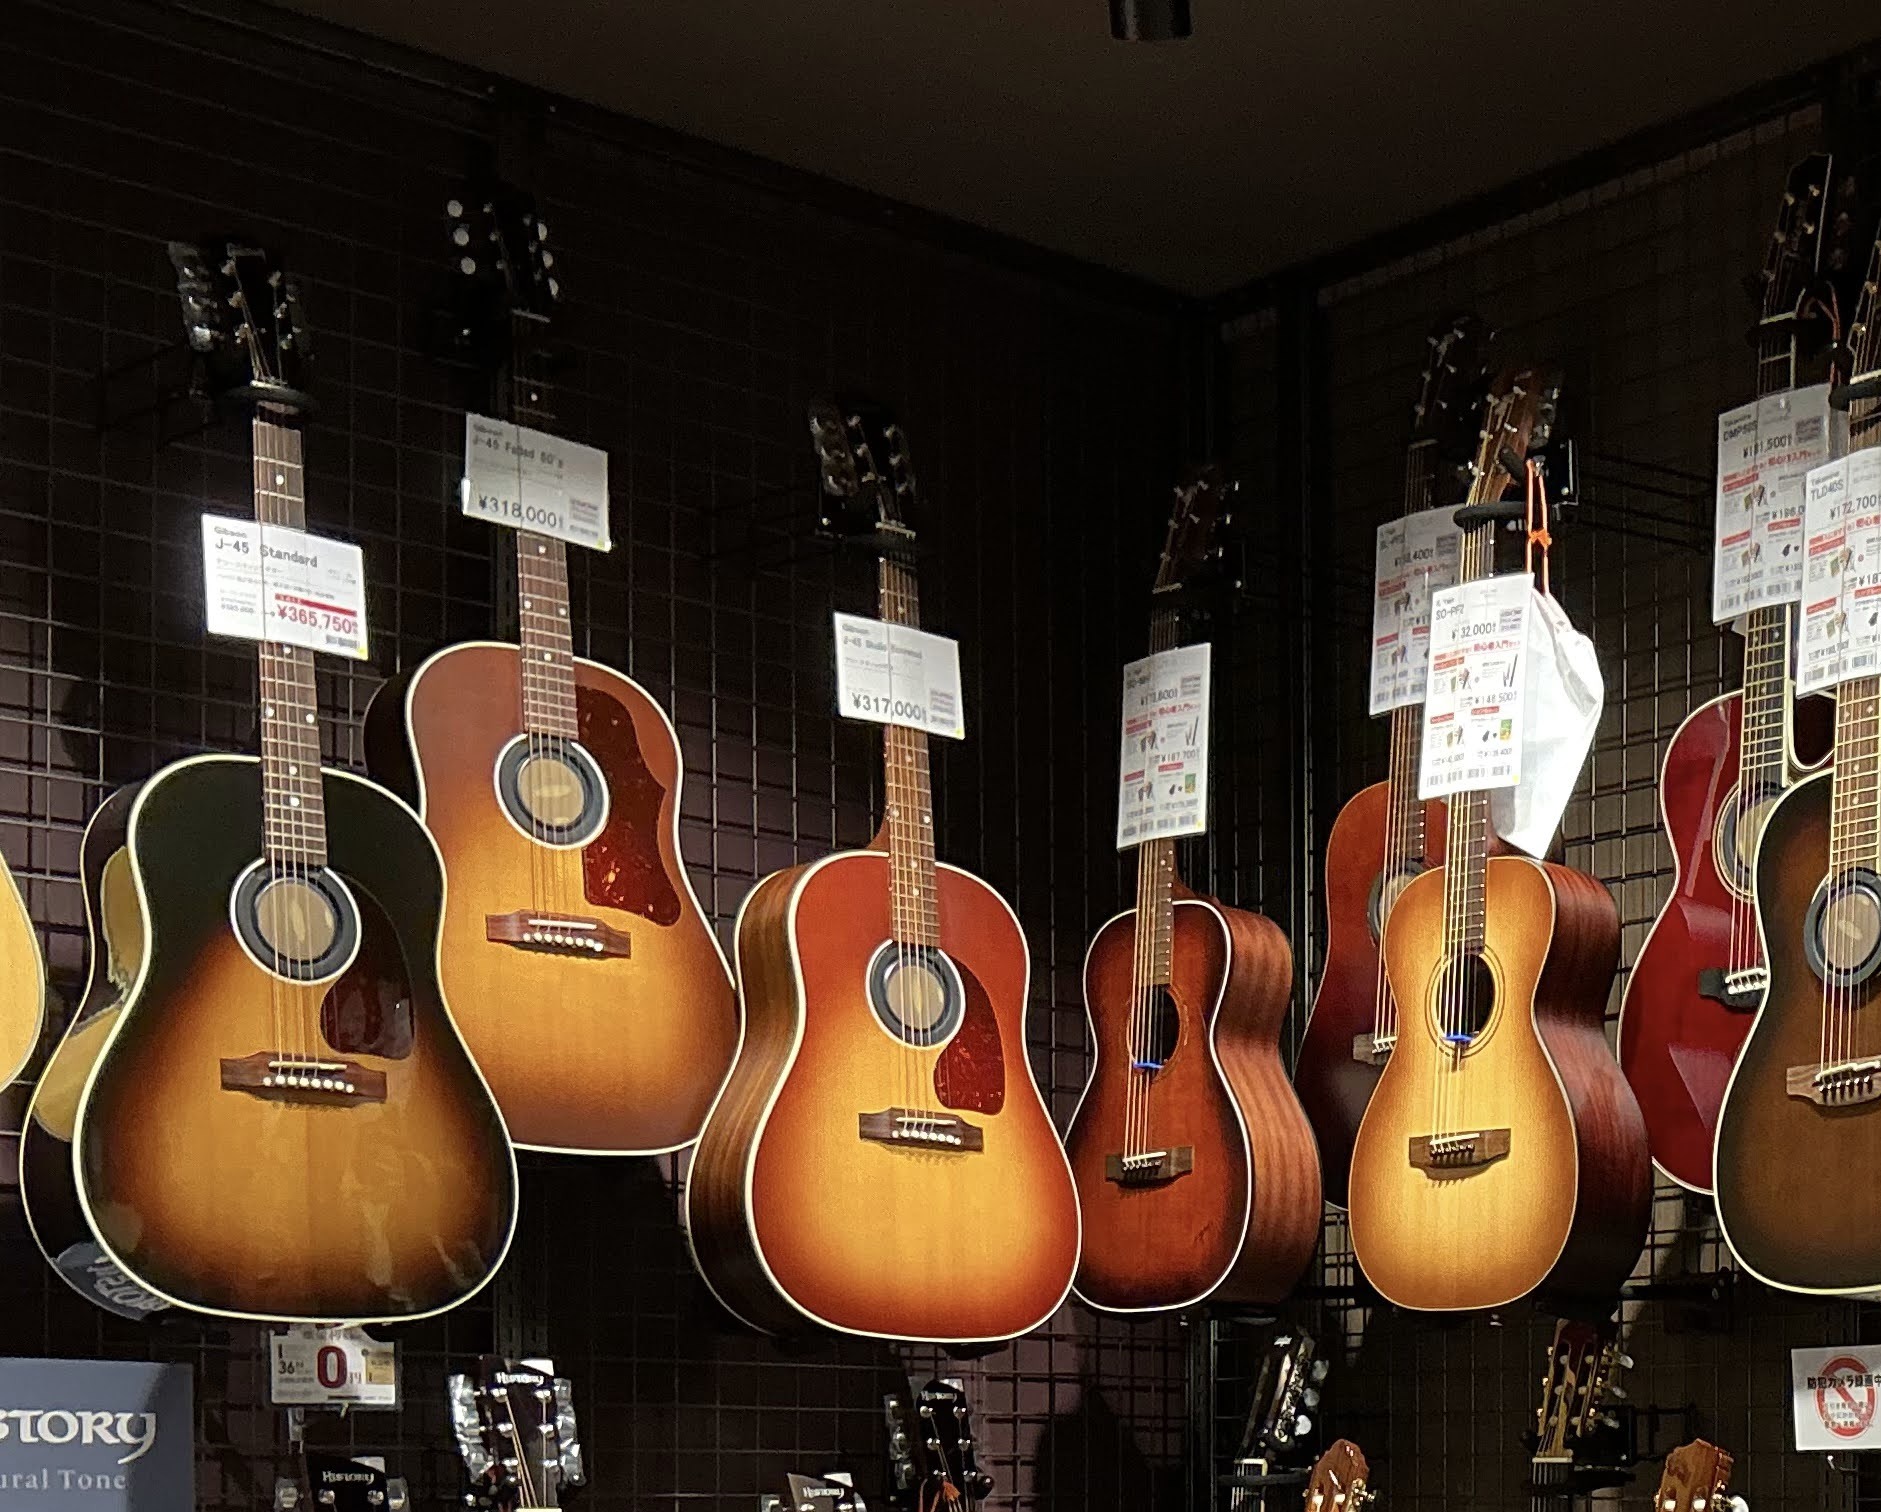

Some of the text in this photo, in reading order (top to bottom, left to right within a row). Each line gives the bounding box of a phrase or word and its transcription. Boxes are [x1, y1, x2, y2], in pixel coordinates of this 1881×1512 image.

[215, 538, 318, 569] J-45 Standard
[57, 1468, 126, 1491] Tone
